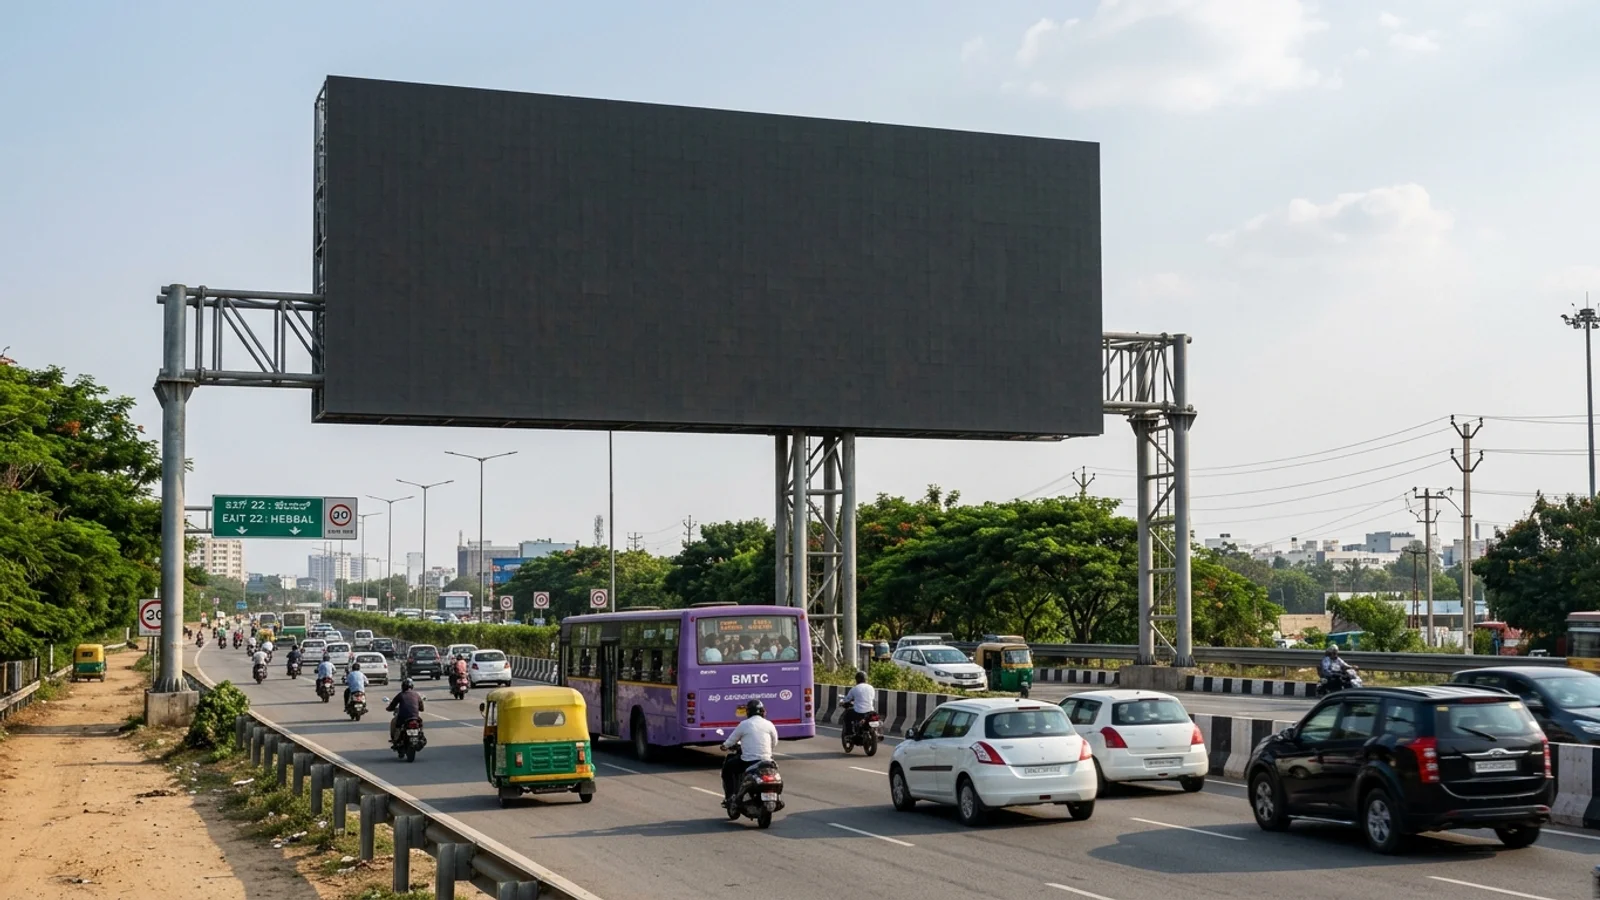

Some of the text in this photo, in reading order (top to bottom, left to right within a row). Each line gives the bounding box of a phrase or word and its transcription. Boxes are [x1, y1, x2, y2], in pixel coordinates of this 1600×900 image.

[251, 500, 265, 510] 22
[271, 514, 314, 524] HEBBAL
[731, 673, 769, 685] BMTC
